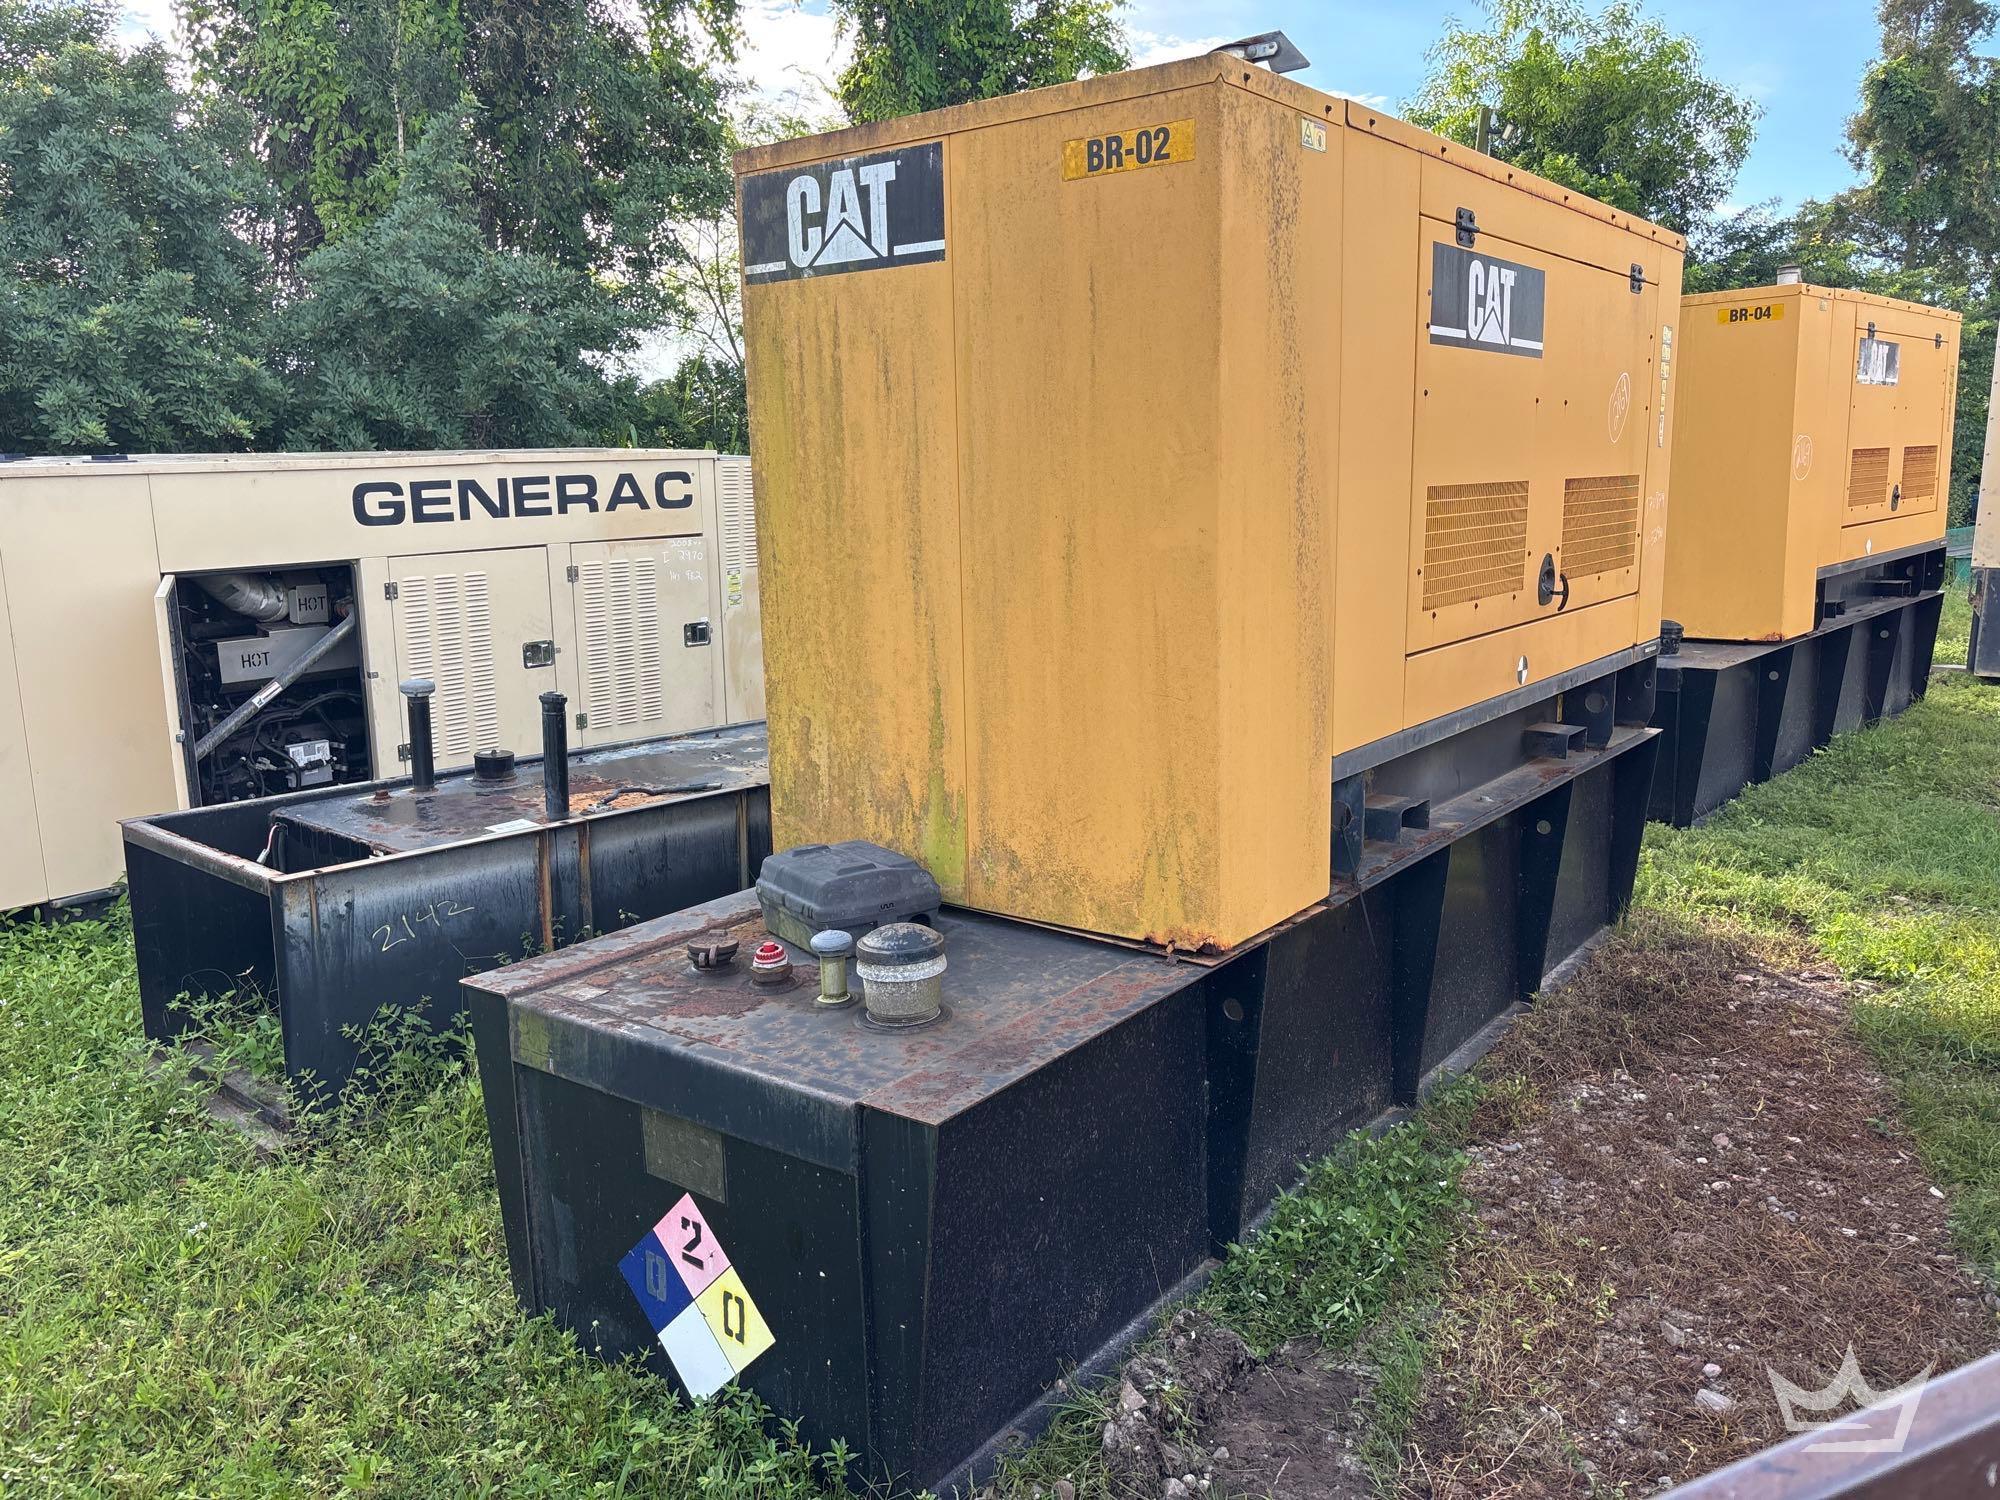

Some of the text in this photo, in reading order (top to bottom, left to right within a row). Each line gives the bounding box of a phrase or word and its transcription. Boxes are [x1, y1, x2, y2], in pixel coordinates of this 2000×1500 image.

[1087, 127, 1171, 173] BR-02
[786, 160, 896, 268] CAT
[1468, 259, 1515, 345] CAT
[1729, 306, 1772, 322] BR-04
[352, 471, 694, 527] GENERAC
[298, 596, 326, 611] HOT
[241, 652, 270, 669] HOT
[681, 1216, 704, 1271] 2
